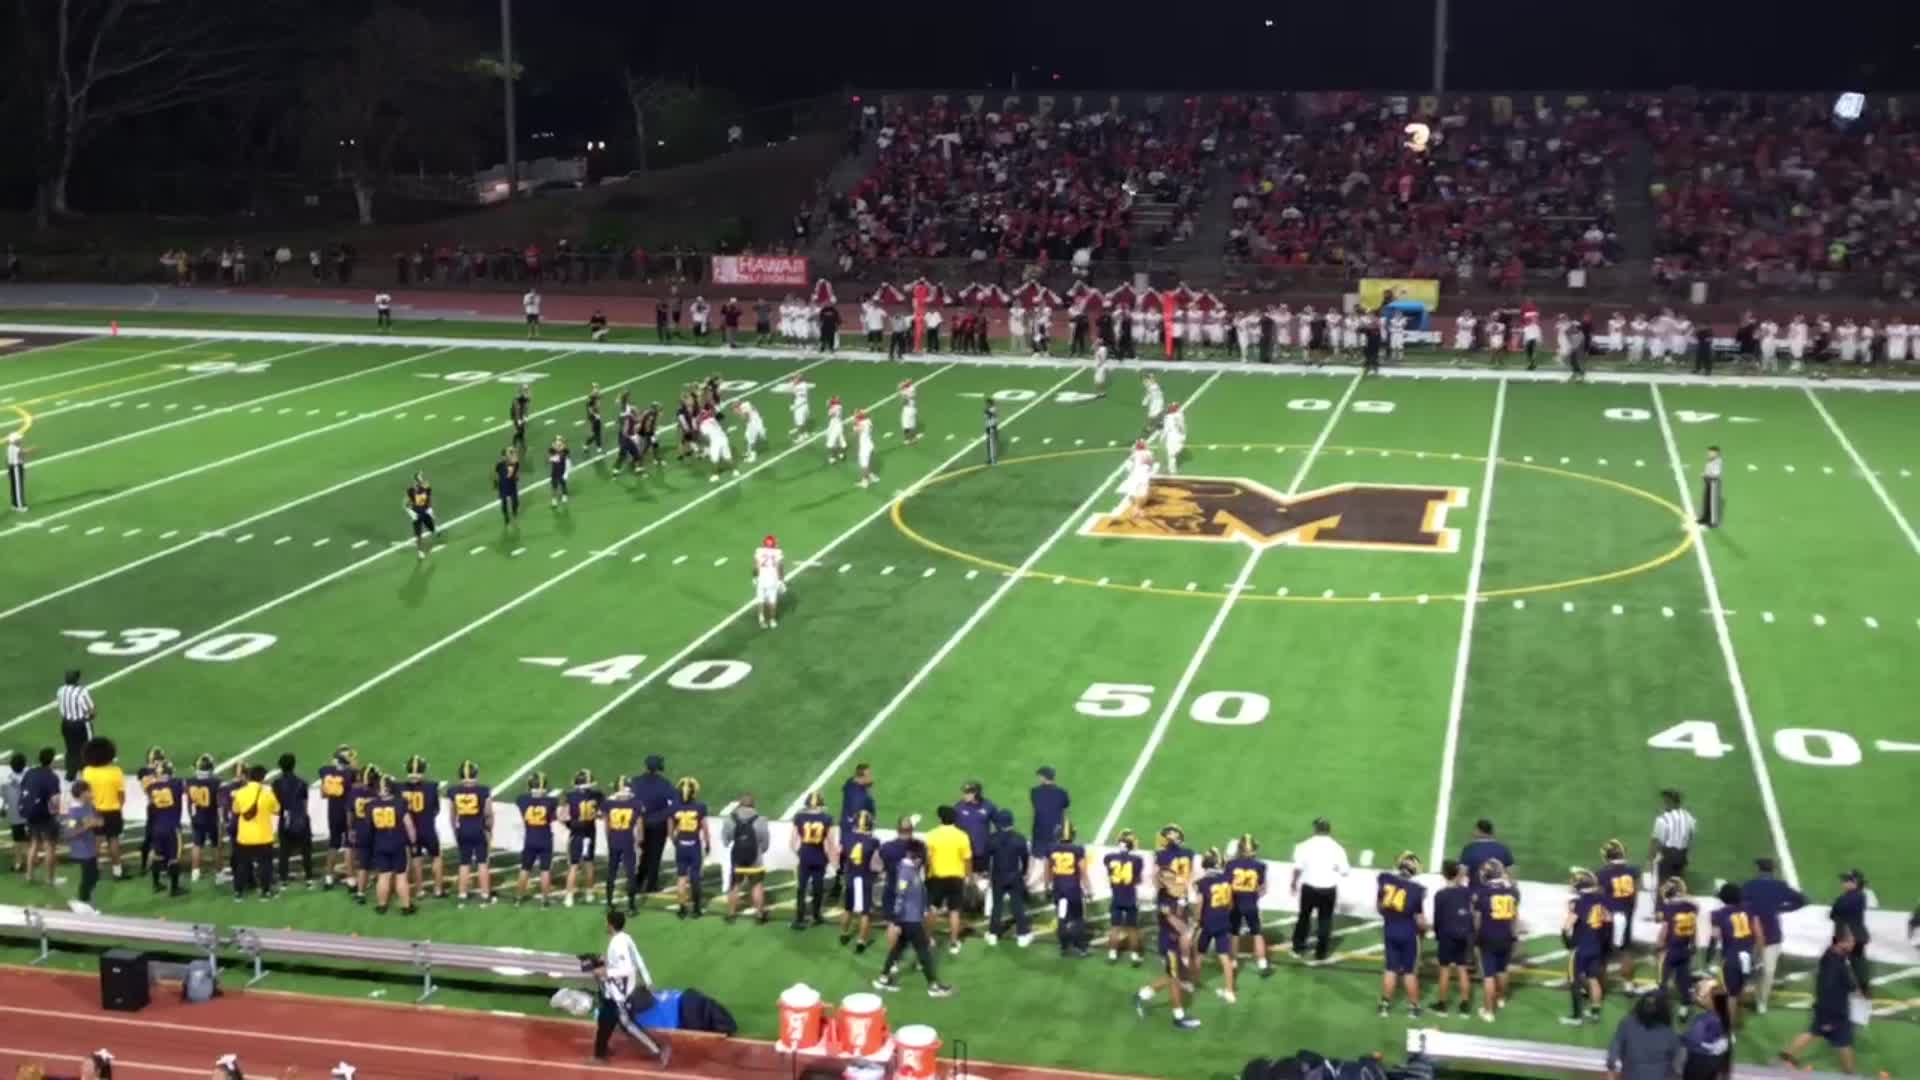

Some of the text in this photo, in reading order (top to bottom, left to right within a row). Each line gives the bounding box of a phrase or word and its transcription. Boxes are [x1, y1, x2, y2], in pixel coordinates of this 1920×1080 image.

[88, 627, 276, 661] 30
[562, 655, 751, 690] 40
[1074, 682, 1270, 725] 50
[1647, 720, 1863, 766] 40
[1109, 859, 1134, 885] 34
